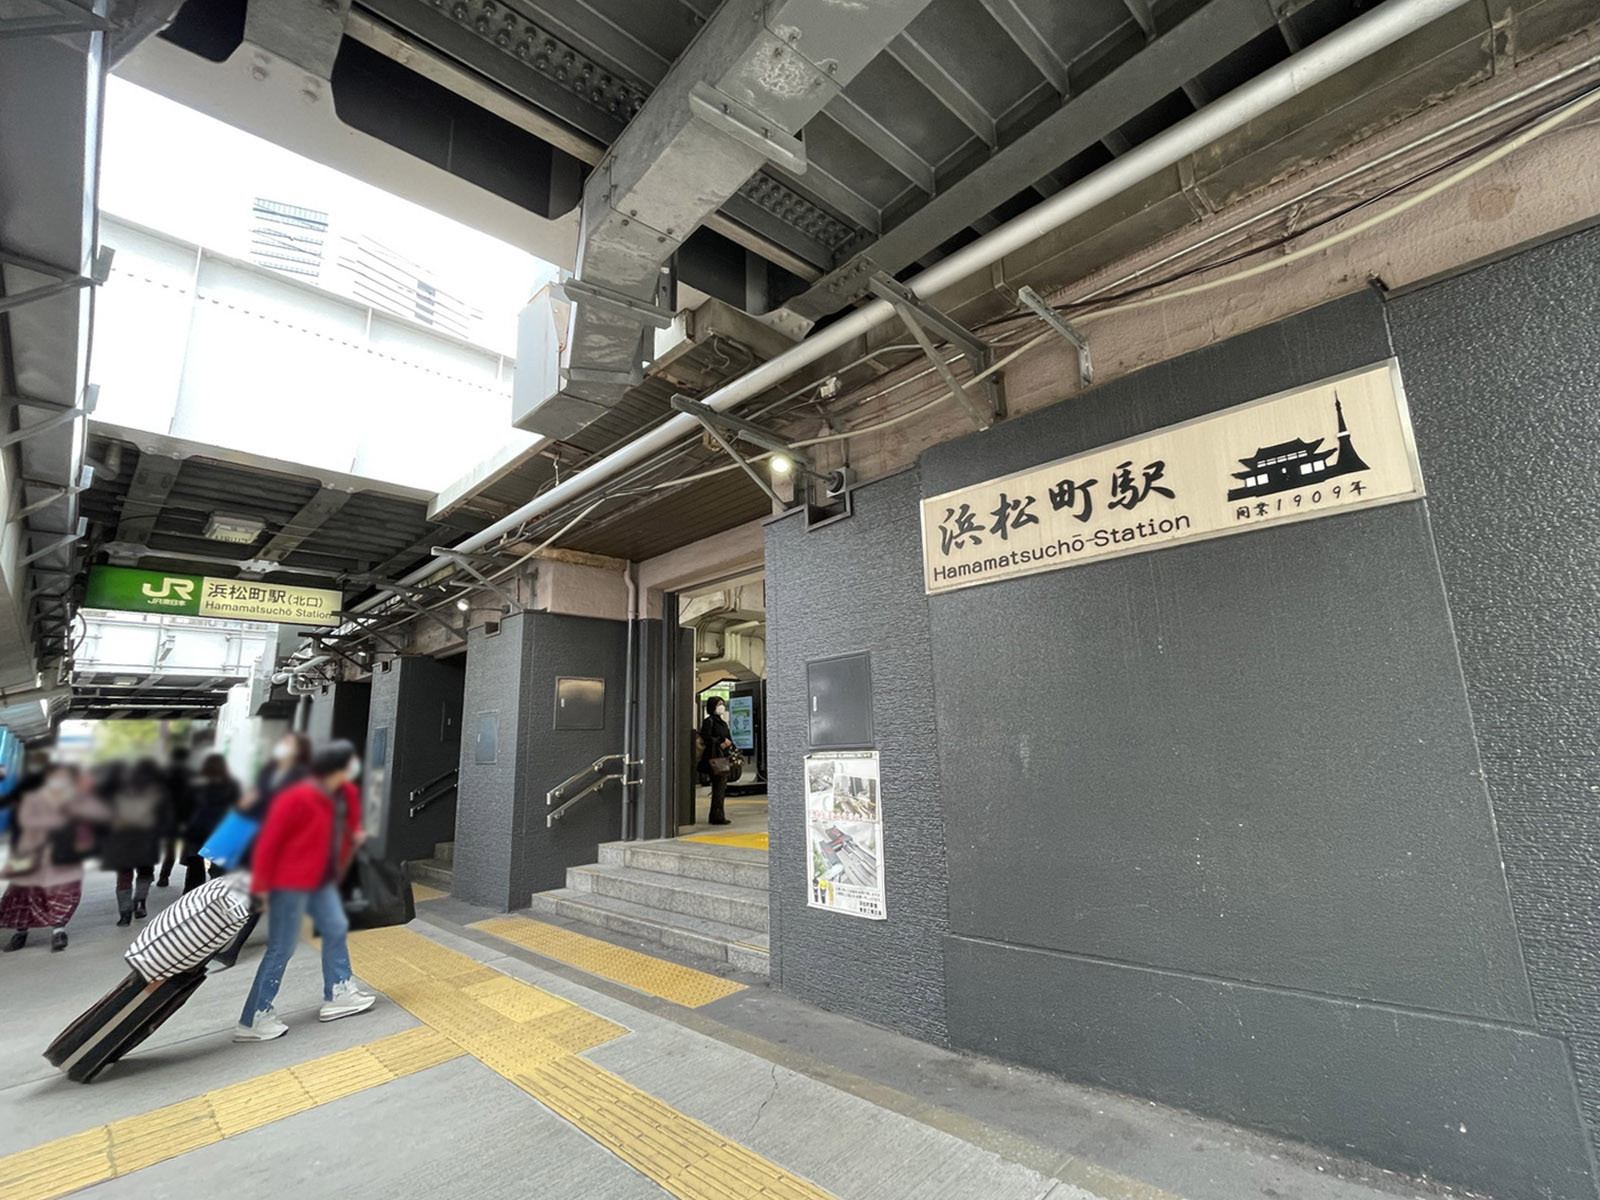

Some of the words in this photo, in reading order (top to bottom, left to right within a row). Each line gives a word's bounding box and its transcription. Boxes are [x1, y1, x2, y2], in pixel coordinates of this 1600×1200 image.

[937, 460, 1176, 556] 浜松町駅
[142, 577, 195, 600] JR
[295, 608, 332, 619] Station
